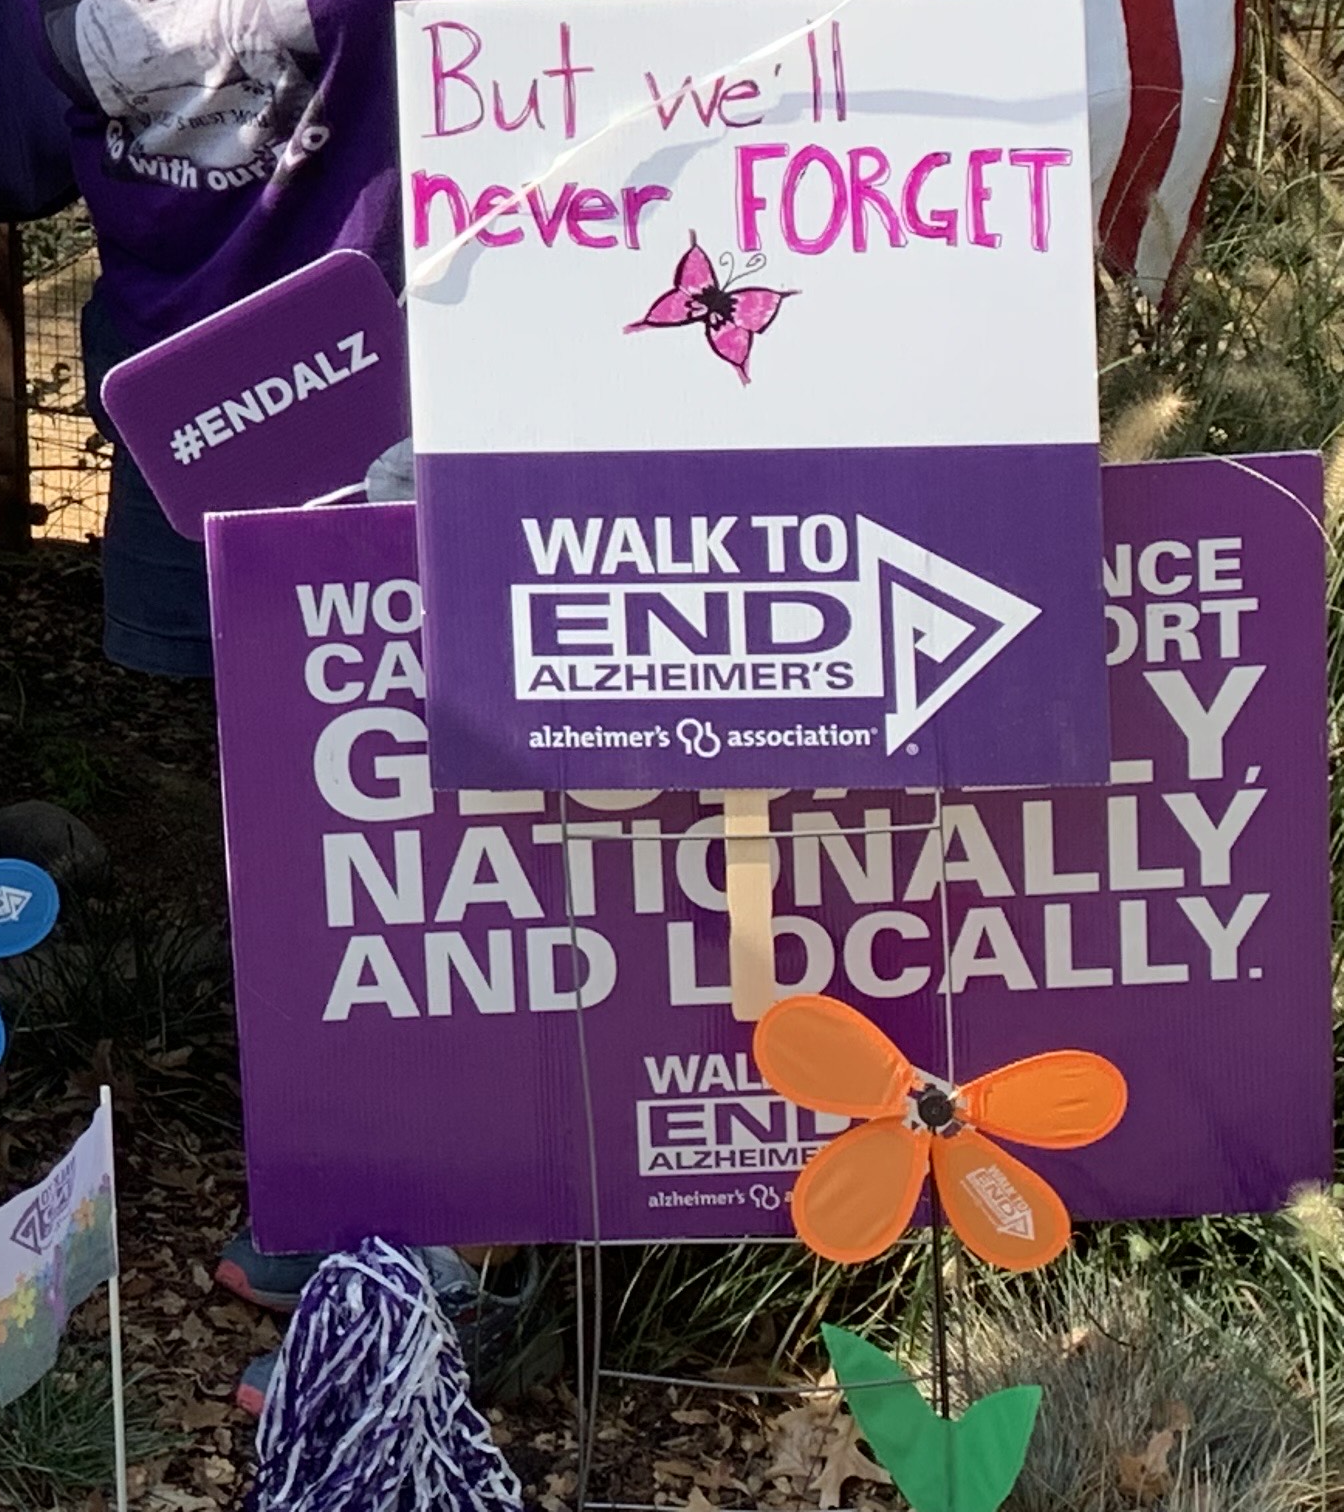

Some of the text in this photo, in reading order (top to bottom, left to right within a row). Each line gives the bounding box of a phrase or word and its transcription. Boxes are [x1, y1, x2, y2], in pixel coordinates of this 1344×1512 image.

[423, 19, 849, 139] But we'll
[128, 154, 198, 189] with
[207, 158, 266, 191] our
[412, 143, 1072, 254] never FORGET
[170, 330, 380, 466] #ENDALZ
[521, 514, 848, 576] WALK TO
[529, 590, 853, 657] END
[529, 661, 855, 692] ALZHEIMER'S
[528, 722, 872, 750] alzheimer's association
[322, 788, 1268, 928] NATIONALLY
[322, 926, 618, 1022] AND
[643, 1052, 772, 1094] WAL
[648, 1189, 746, 1208] alzheimer's
[975, 1171, 1015, 1216] END
